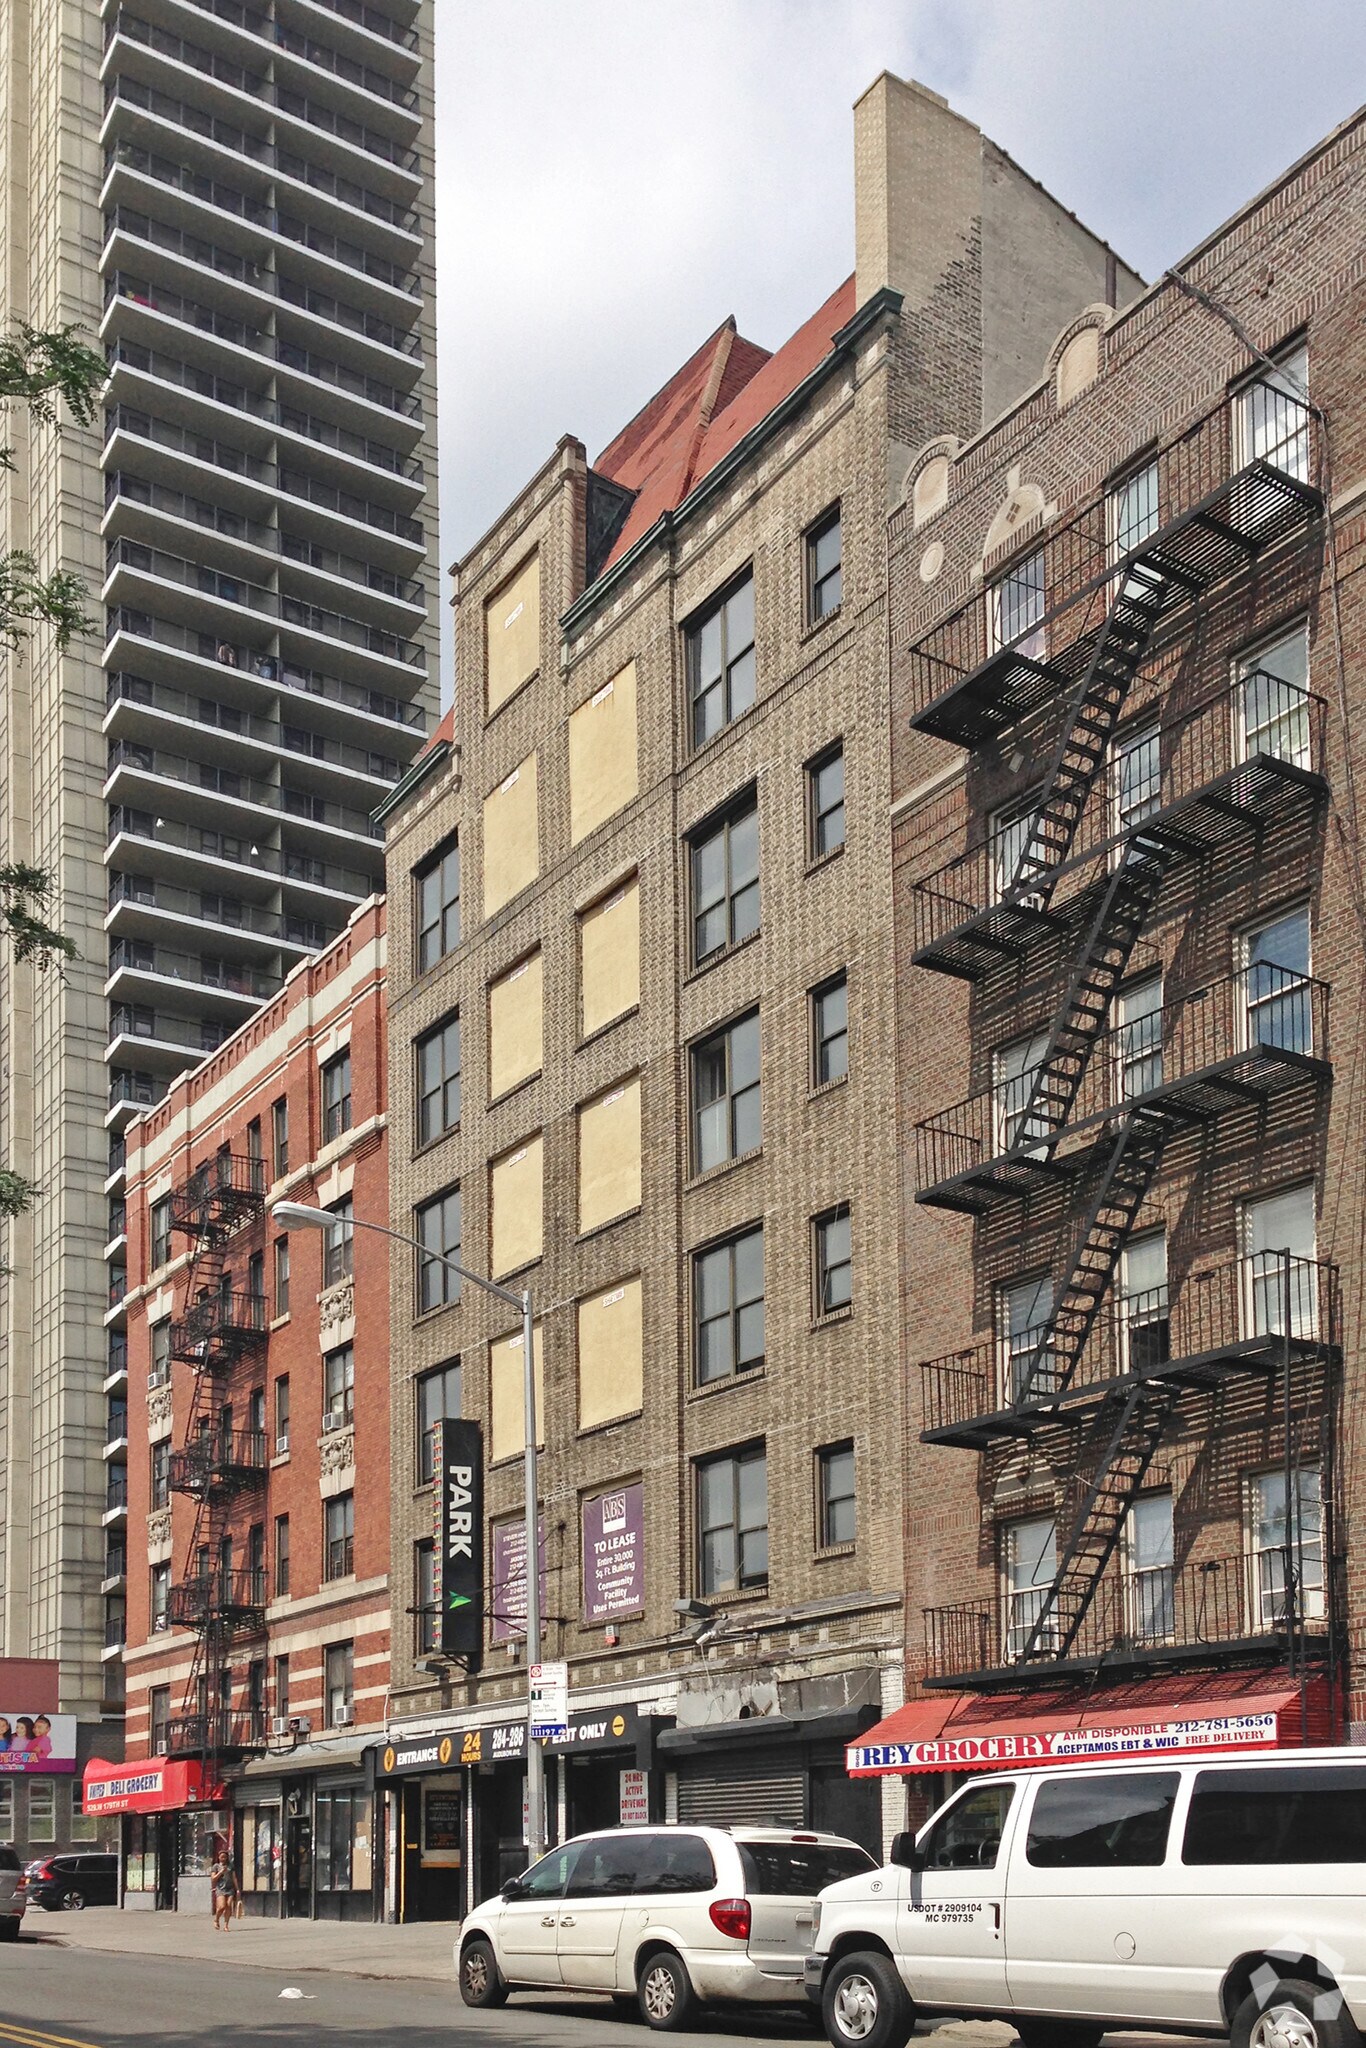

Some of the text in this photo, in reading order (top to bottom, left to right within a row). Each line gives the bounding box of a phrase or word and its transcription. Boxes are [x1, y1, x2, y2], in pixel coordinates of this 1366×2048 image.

[449, 1465, 472, 1559] PARK
[604, 1497, 625, 1521] ABS
[594, 1532, 636, 1554] TO LEASE
[597, 1549, 634, 1568] Entire 30,000
[611, 1561, 636, 1575] Building
[597, 1575, 634, 1592] Community
[604, 1587, 628, 1601] Facility
[592, 1594, 640, 1614] Uses Permitted
[579, 1722, 608, 1741] ONLY
[1063, 1724, 1169, 1741] ATM DISPONIBLE
[1174, 1714, 1274, 1733] 212-781-5656
[463, 1731, 481, 1752] 24
[491, 1726, 525, 1750] 284-286
[1056, 1736, 1180, 1755] ACEPTAMOS EBT & WIC
[1184, 1730, 1266, 1745] FREE DELIVERY
[0, 1752, 39, 1763] TISTA
[396, 1747, 439, 1766] ENTRANCE
[461, 1751, 482, 1763] HOURS
[862, 1733, 1056, 1766] REY GROCERY
[110, 1781, 125, 1795] DELI
[126, 1774, 158, 1793] GROCERY
[625, 1785, 643, 1796] ACTIVE
[621, 1799, 646, 1809] DRIVEWAY
[907, 1903, 982, 1913] USDOT # 2909104
[925, 1914, 974, 1923] MC 979735
